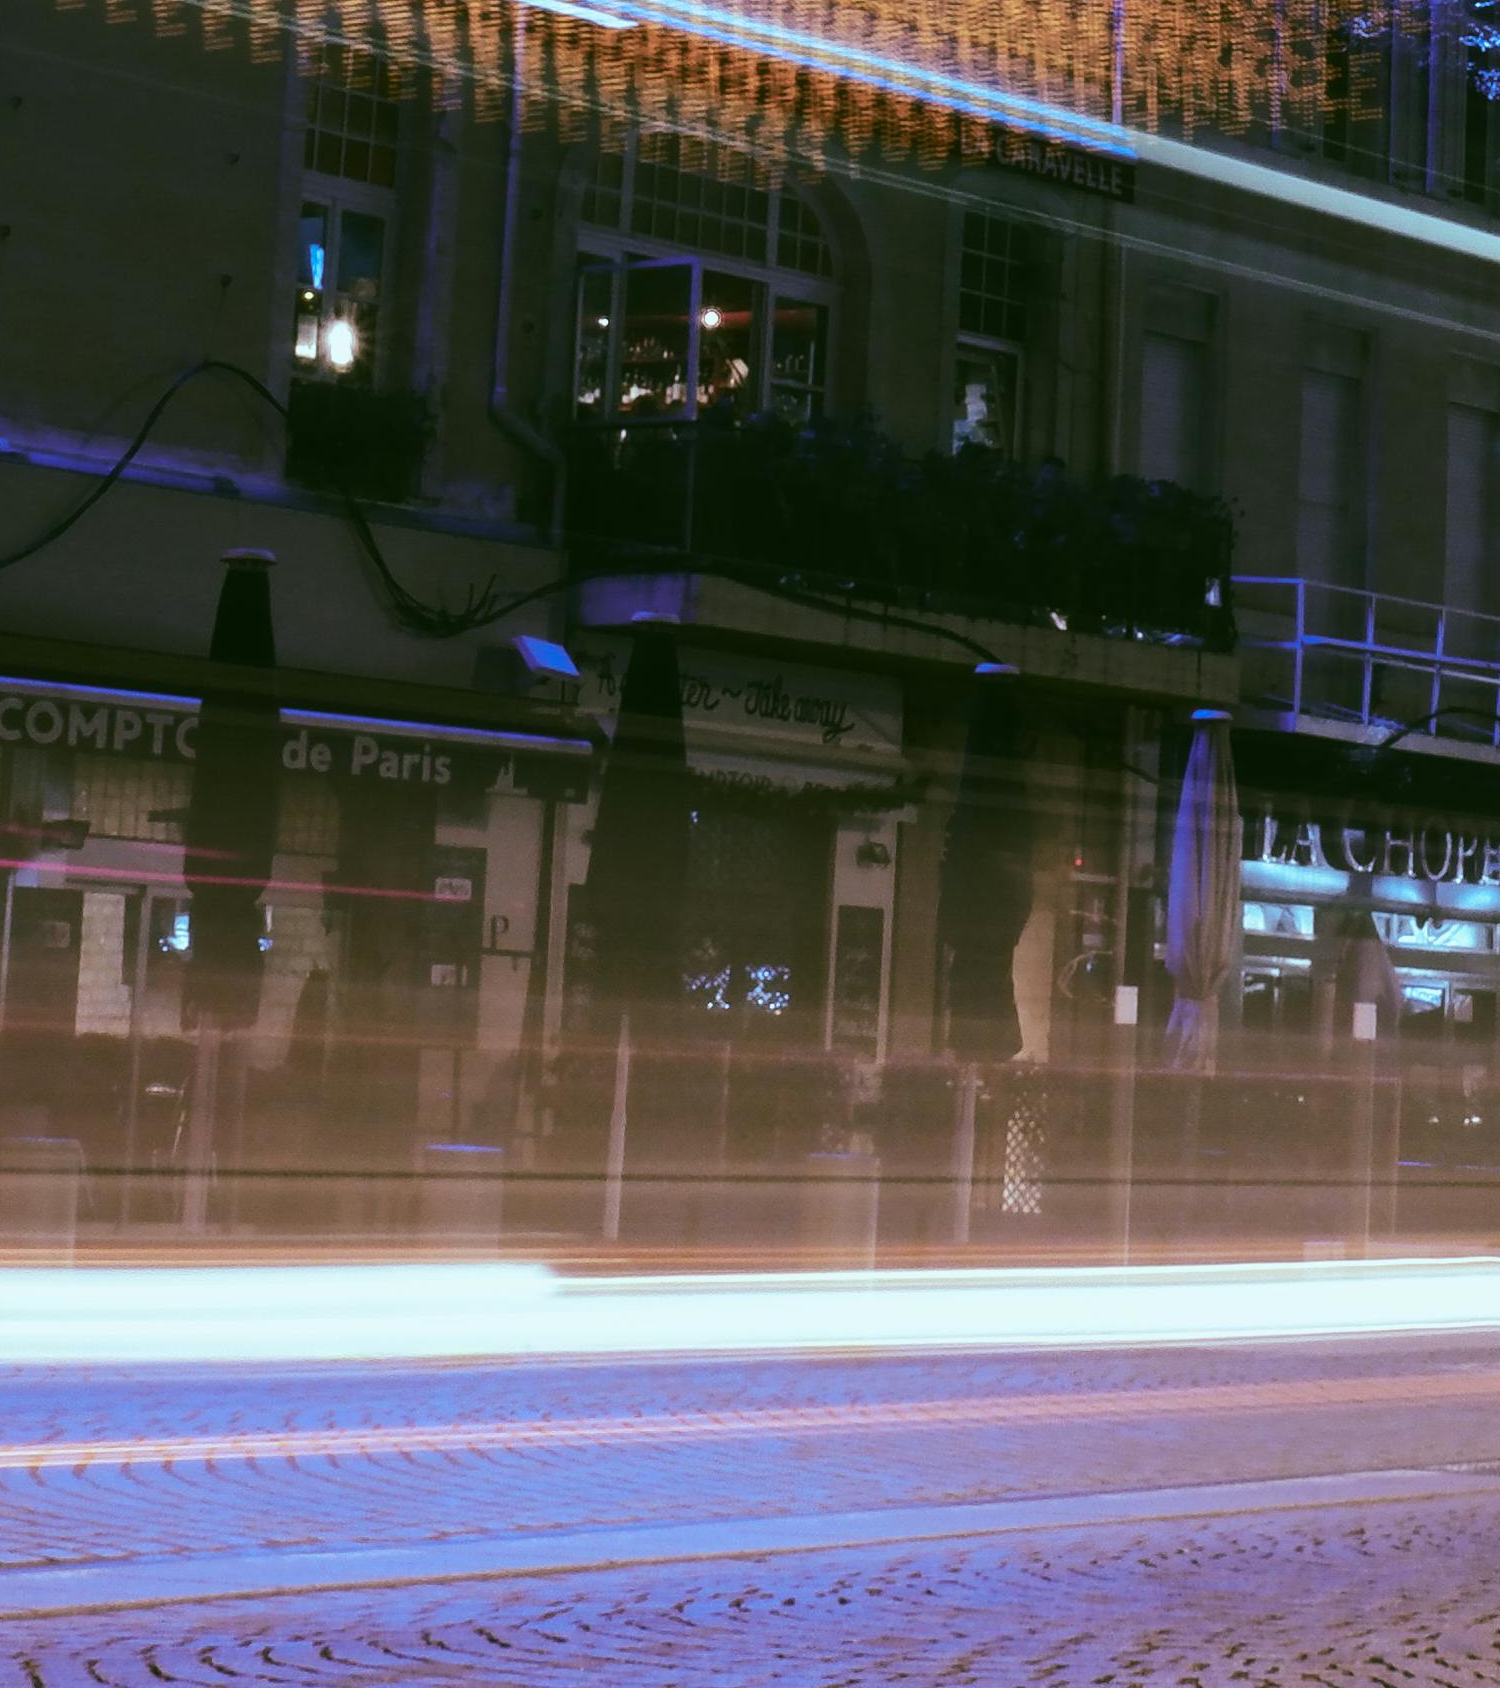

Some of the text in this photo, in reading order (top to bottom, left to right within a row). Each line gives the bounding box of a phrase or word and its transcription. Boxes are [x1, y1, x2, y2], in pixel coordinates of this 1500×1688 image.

[281, 729, 332, 772] de
[350, 736, 452, 785] Paris
[1260, 812, 1336, 870] LA
